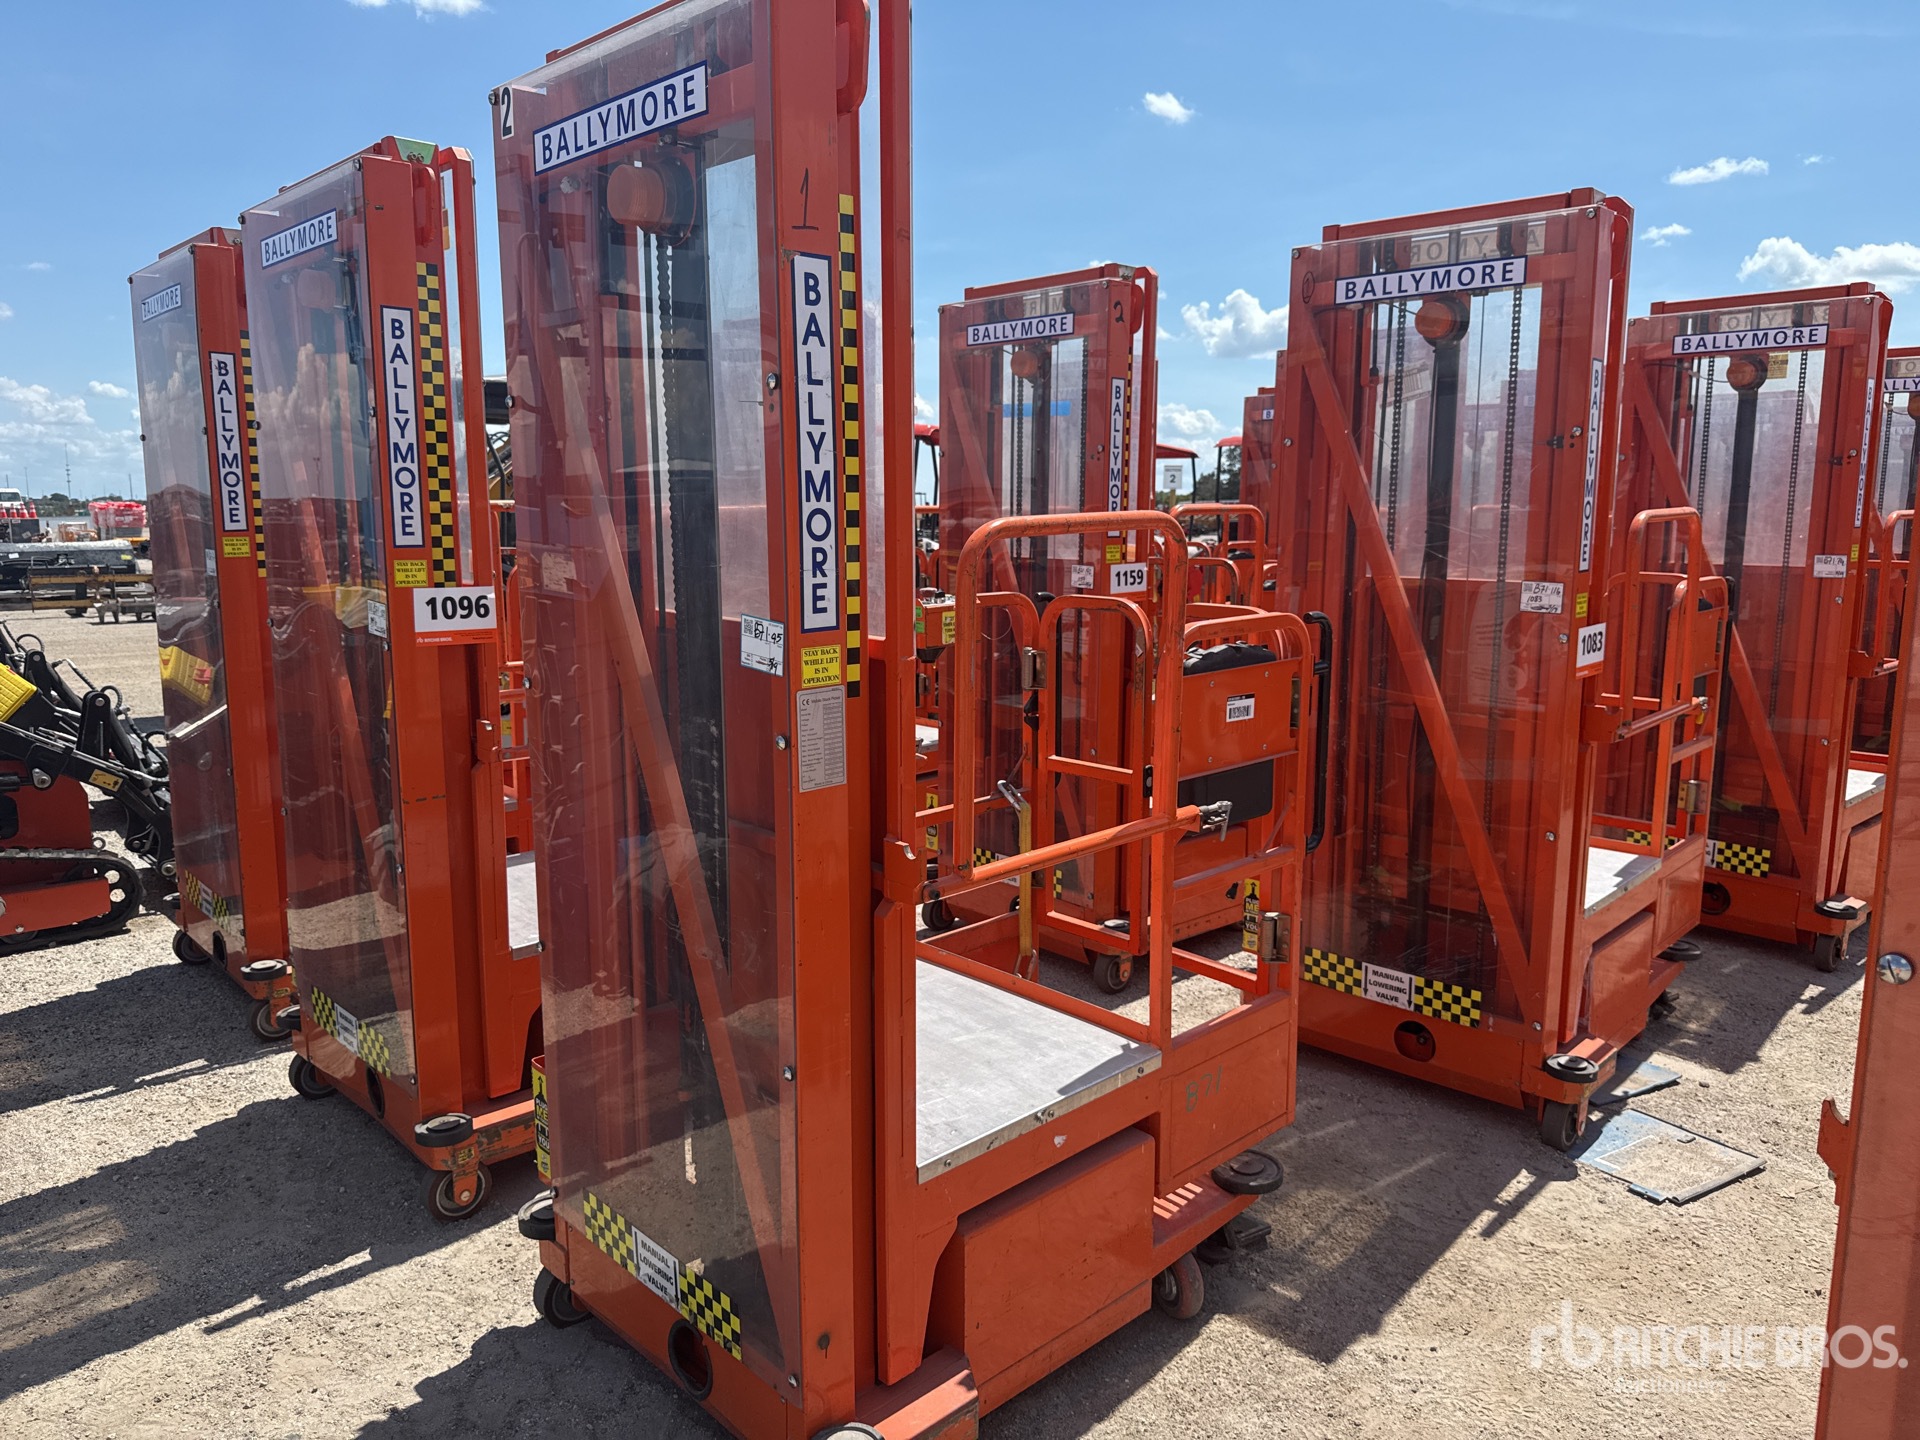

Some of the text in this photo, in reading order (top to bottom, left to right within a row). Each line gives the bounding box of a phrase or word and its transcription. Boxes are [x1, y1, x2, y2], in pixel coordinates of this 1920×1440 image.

[501, 86, 513, 138] 2
[541, 74, 697, 164] BALLYMORE
[791, 167, 819, 231] 1
[264, 214, 334, 267] BALLYMORE
[1345, 261, 1515, 300] BALLYMORE
[1113, 300, 1125, 323] 2
[972, 316, 1069, 342] BALLYMORE
[1681, 327, 1819, 352] BALLYMORE
[390, 318, 416, 537] BALLYMORE
[217, 360, 241, 524] BALLYMORE
[801, 270, 832, 614] BALLYMORE
[1110, 385, 1122, 512] BALLYMOR
[1856, 387, 1873, 521] BALLYMORE
[1169, 474, 1176, 483] 2
[1582, 369, 1599, 563] BALLYMORE
[1115, 569, 1144, 587] 1159
[425, 595, 490, 620] 1096
[803, 647, 838, 657] STAY BACK
[1581, 631, 1603, 656] 1083
[803, 656, 839, 666] WHILE LIFT
[821, 666, 829, 674] IN
[803, 674, 840, 685] OPERATION
[1368, 978, 1407, 995] LOWERING
[1371, 969, 1405, 983] MANUAL
[1375, 990, 1399, 1003] VALVE
[640, 1239, 671, 1269] MANUAL
[639, 1252, 674, 1287] LOWERING
[646, 1272, 669, 1296] VALVE
